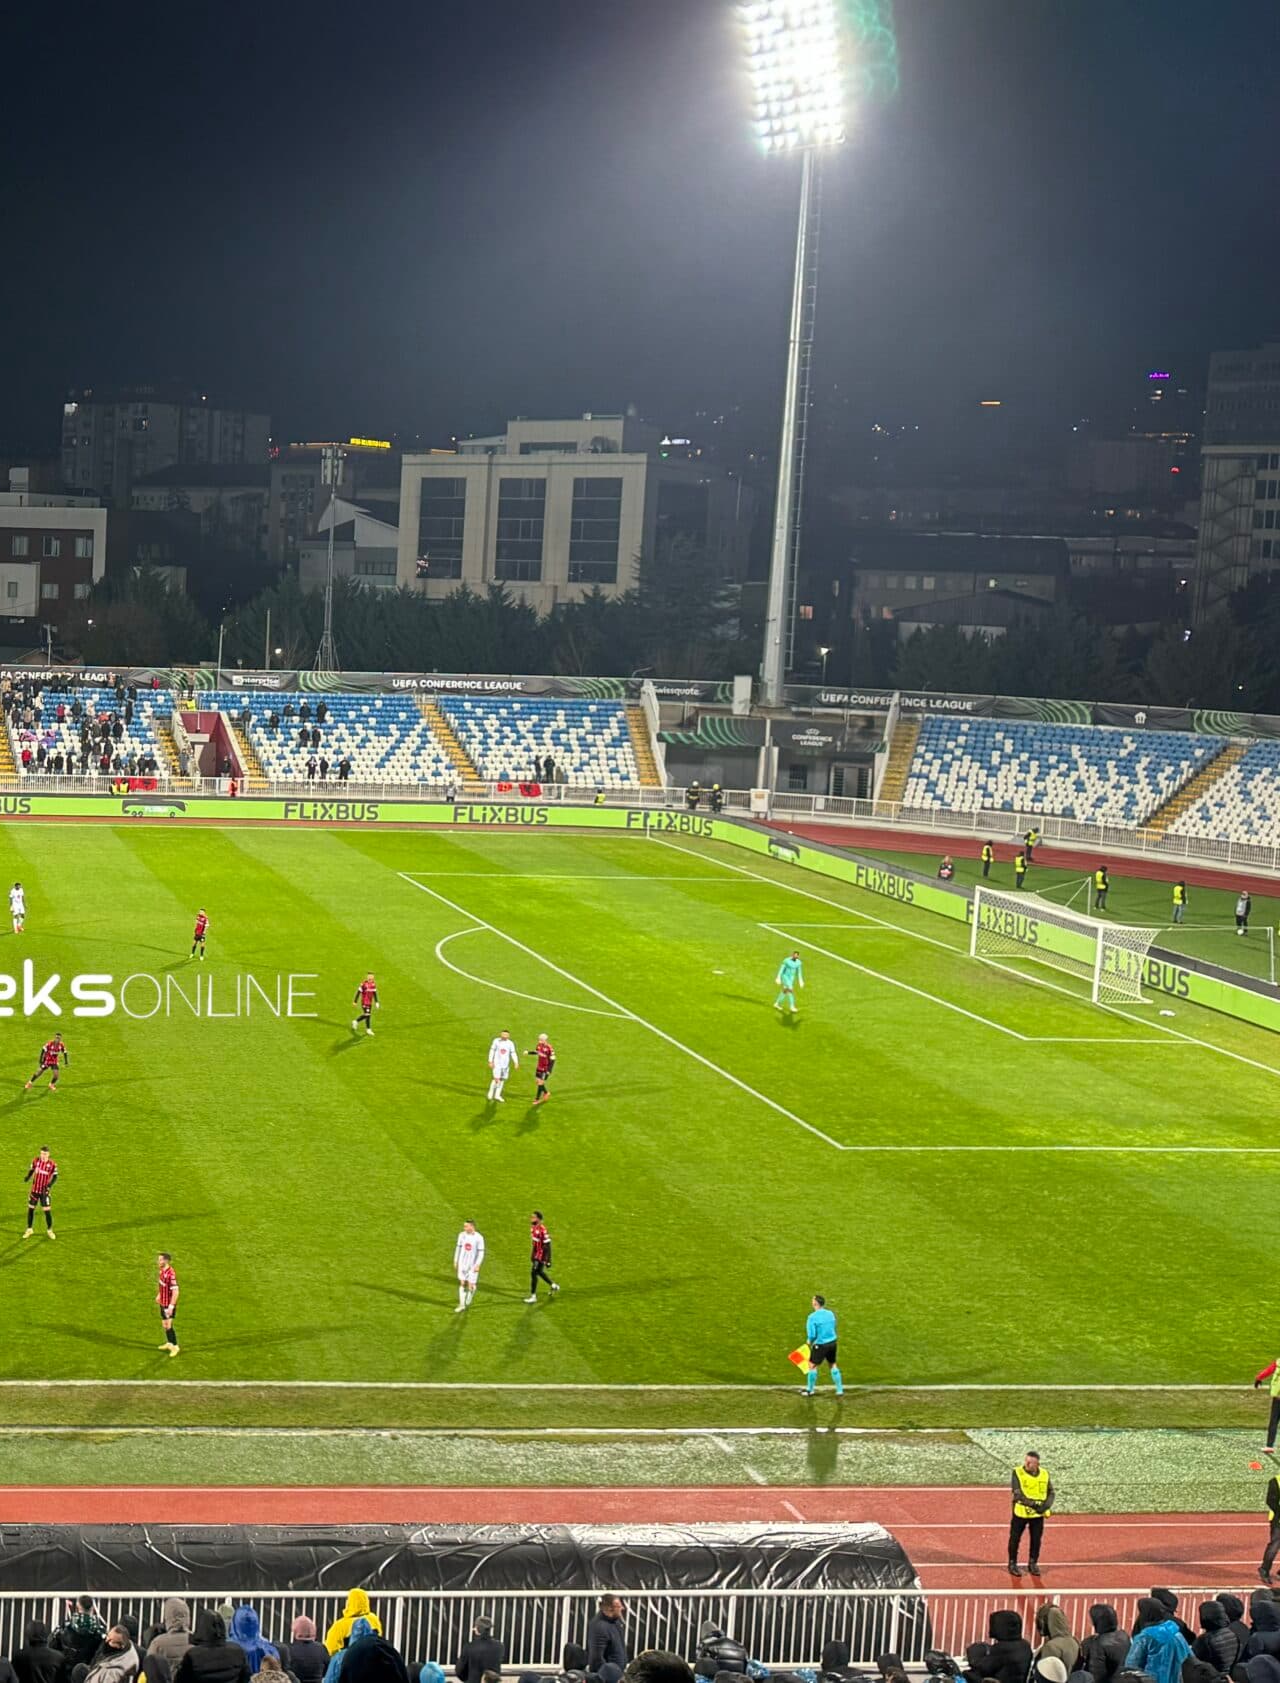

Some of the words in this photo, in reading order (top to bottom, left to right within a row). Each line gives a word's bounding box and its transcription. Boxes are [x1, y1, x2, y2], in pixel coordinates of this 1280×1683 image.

[392, 679, 418, 688] UEFA
[420, 680, 482, 689] CONFERENCE
[484, 681, 522, 690] LEAGUE
[930, 698, 973, 711] LEAGUE
